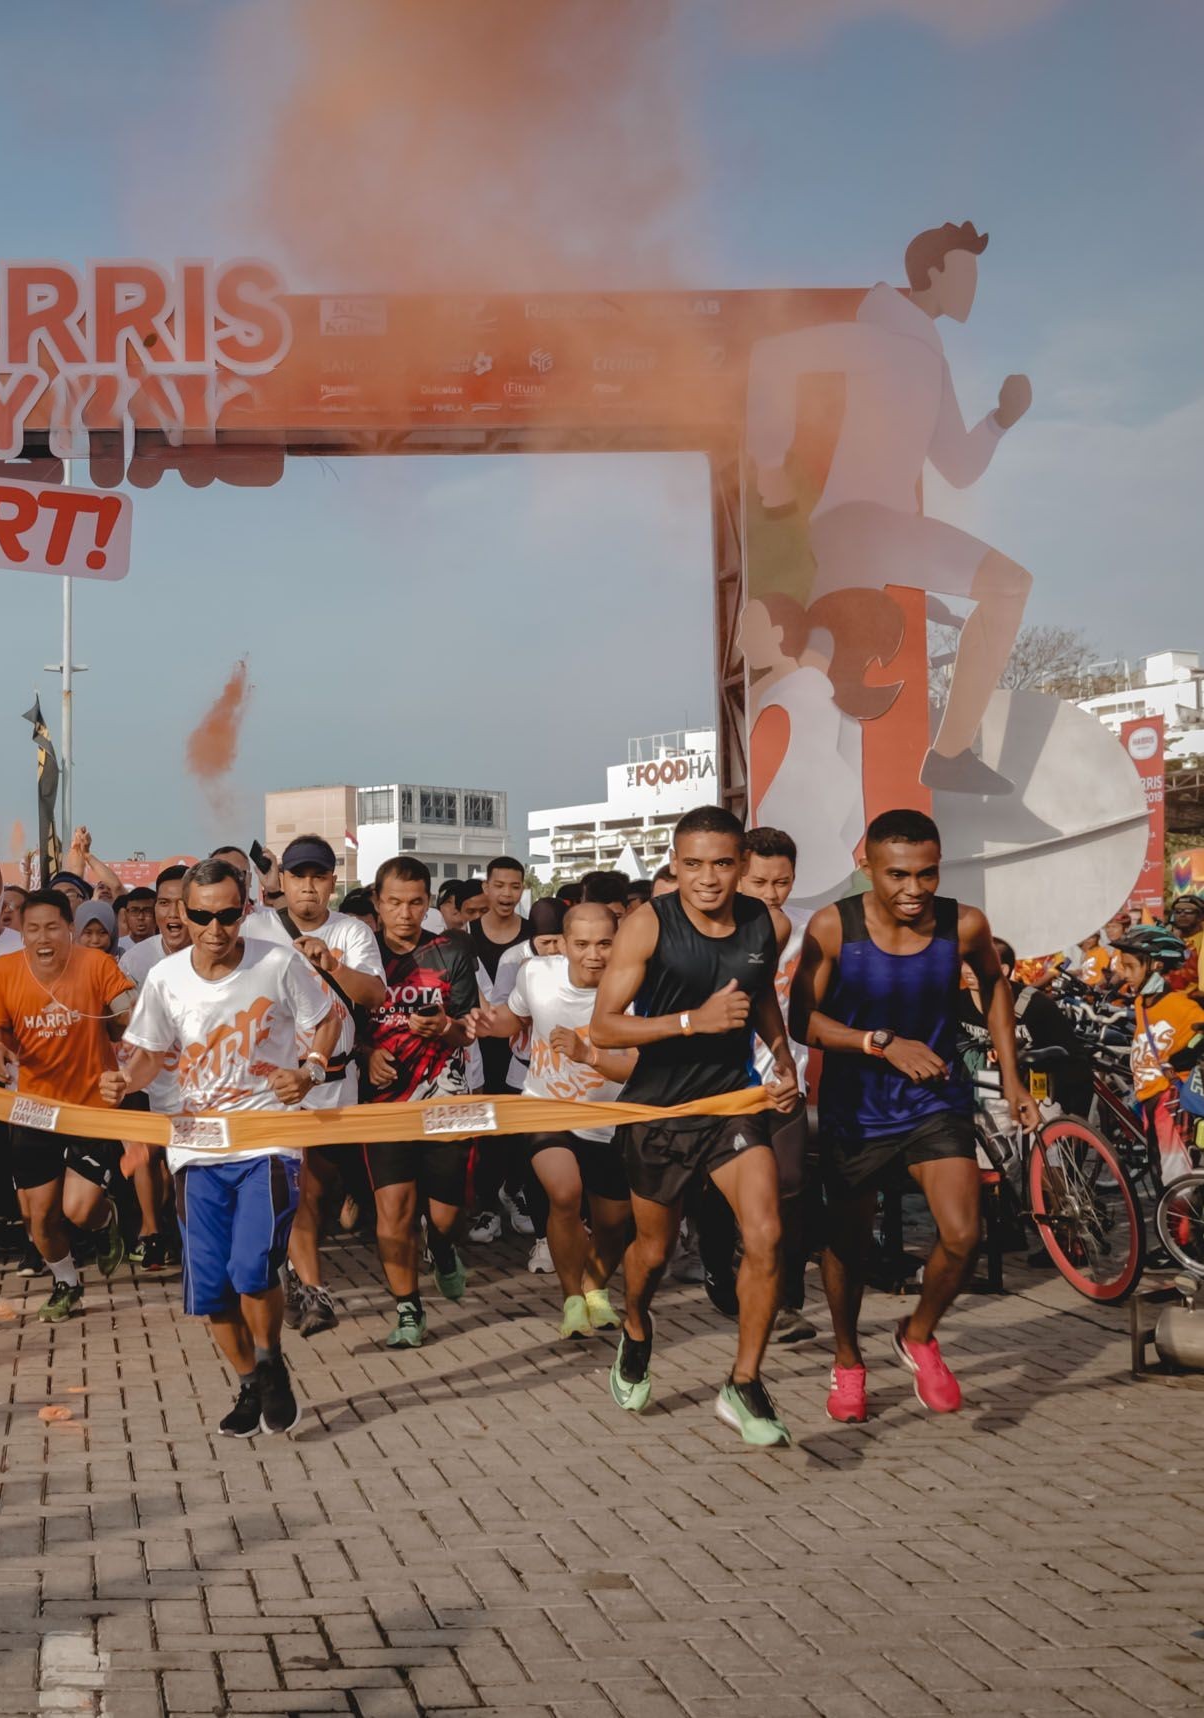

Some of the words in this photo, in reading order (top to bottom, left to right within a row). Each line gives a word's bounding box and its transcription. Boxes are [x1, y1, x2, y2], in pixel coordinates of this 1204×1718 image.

[635, 753, 716, 787] FOODHA
[1140, 774, 1163, 790] RRIS
[386, 985, 444, 1005] YOTA
[23, 1010, 81, 1029] HARRIS
[15, 1099, 55, 1117] HARRIS
[423, 1103, 488, 1122] HARRIS
[173, 1120, 222, 1136] HARRIS
